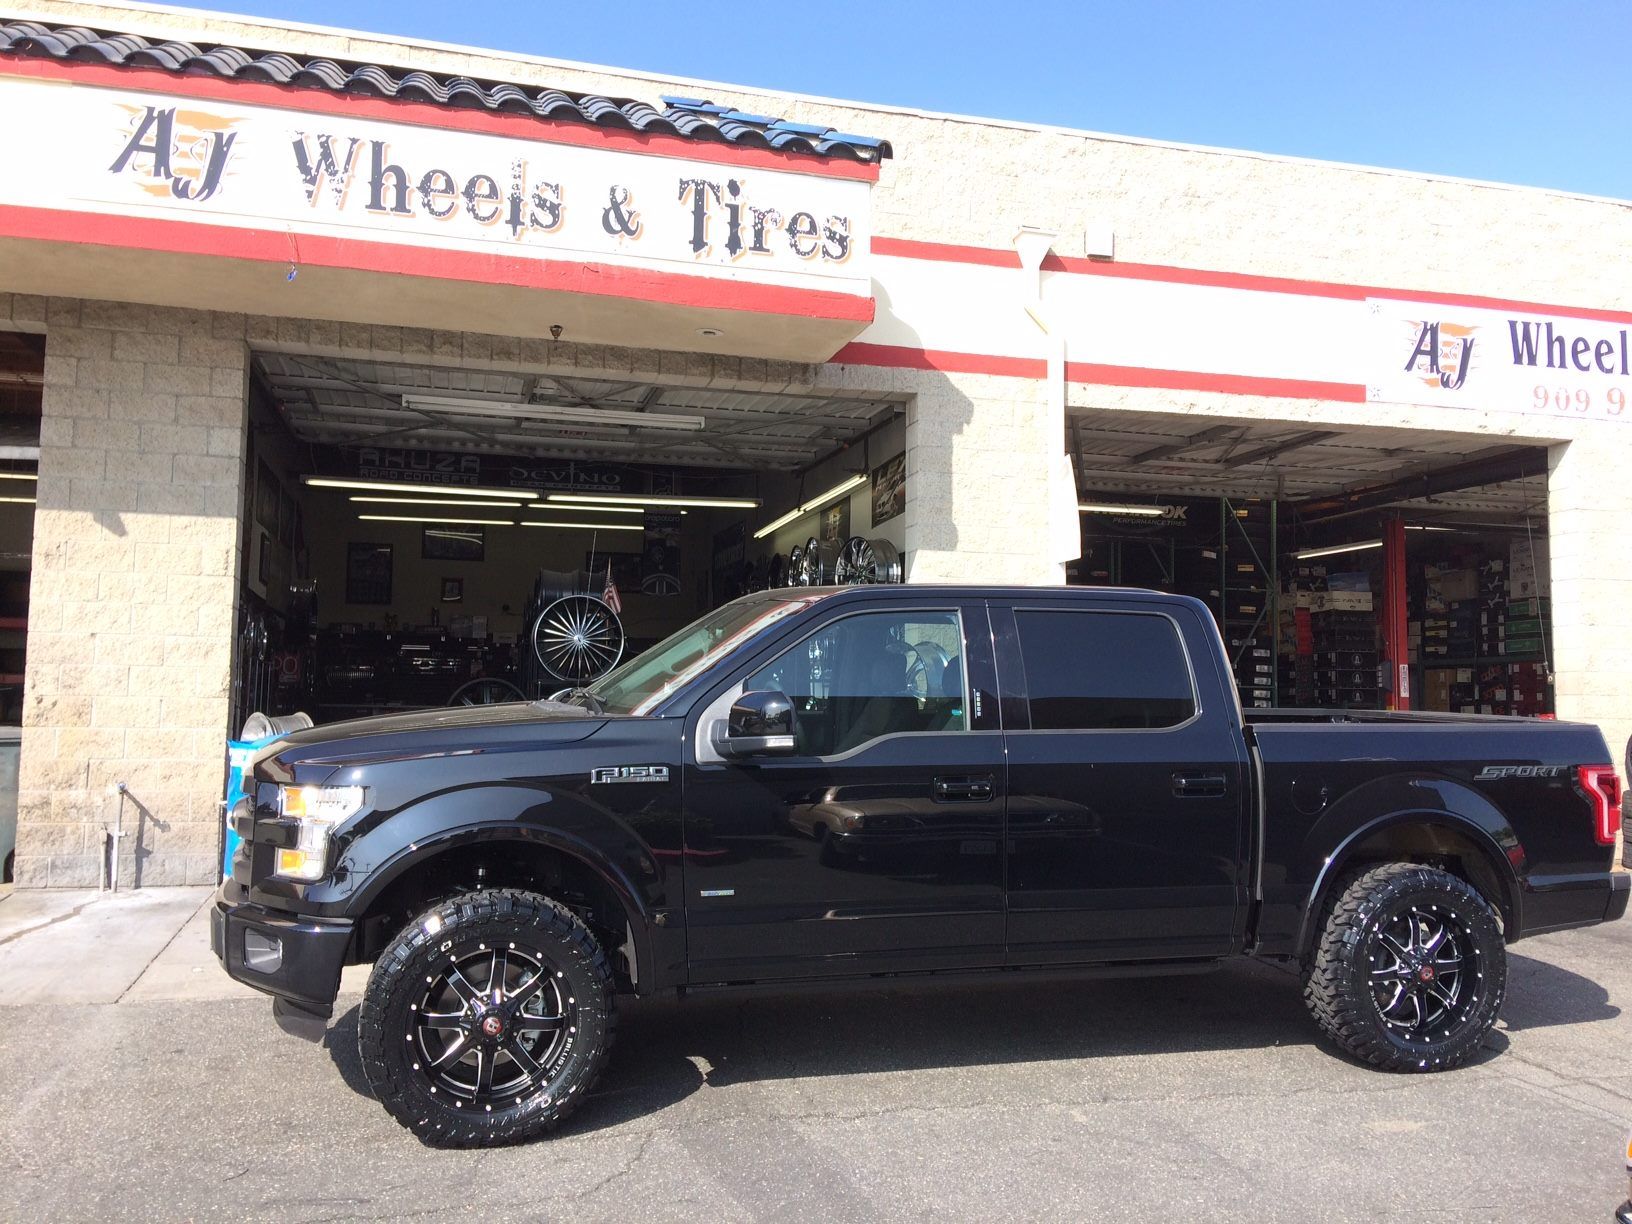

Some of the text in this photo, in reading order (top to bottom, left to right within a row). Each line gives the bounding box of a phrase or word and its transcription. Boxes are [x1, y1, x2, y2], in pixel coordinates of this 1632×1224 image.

[108, 105, 852, 261] AJ Wheels & Tires
[1404, 320, 1475, 390] AJ
[1533, 385, 1591, 413] 909
[1474, 765, 1568, 781] SPORT
[549, 1037, 574, 1079] BALLISTIC
